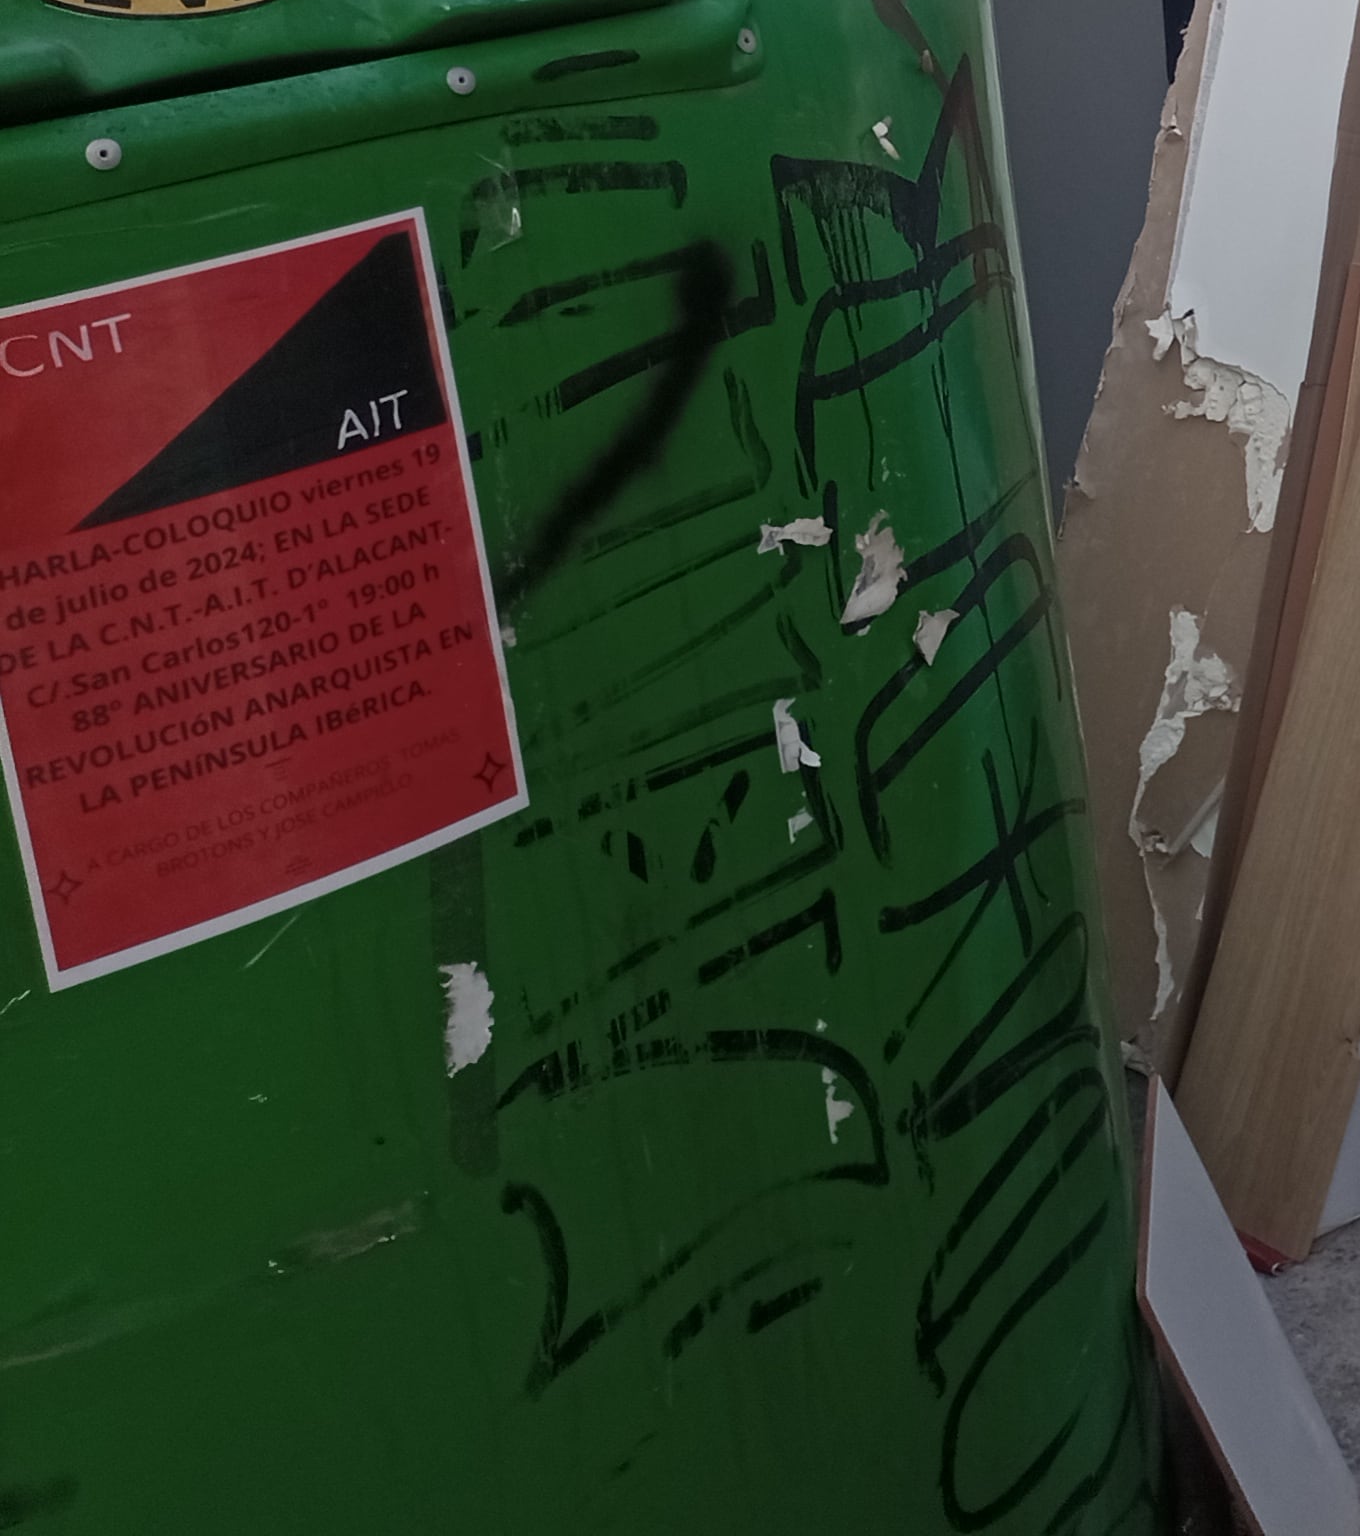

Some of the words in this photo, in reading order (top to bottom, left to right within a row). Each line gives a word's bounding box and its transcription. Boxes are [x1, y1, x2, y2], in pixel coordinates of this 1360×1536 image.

[0, 312, 132, 378] CNT
[337, 389, 409, 451] AIT
[300, 458, 406, 505] viernes
[411, 443, 441, 468] 19
[6, 605, 46, 631] de
[55, 583, 129, 626] julio
[138, 568, 178, 594] de
[185, 540, 265, 582] 2024;
[273, 523, 314, 554] EN
[321, 511, 359, 539] LA
[365, 485, 431, 525] SEDE
[346, 569, 416, 609] 19:00
[423, 562, 440, 583] h
[47, 632, 91, 662] LA
[134, 630, 340, 715] ANIVERSARIO
[348, 615, 385, 645] DE
[391, 601, 427, 629] LA
[244, 638, 432, 722] ANARQUISTA
[438, 621, 474, 652] EN
[79, 783, 123, 814] LA
[104, 831, 180, 867] CARGO
[184, 819, 215, 843] DE
[216, 807, 257, 833] LOS
[258, 759, 392, 816] COMPAÑEROS
[156, 834, 255, 879] BROTONS
[256, 826, 271, 842] Y
